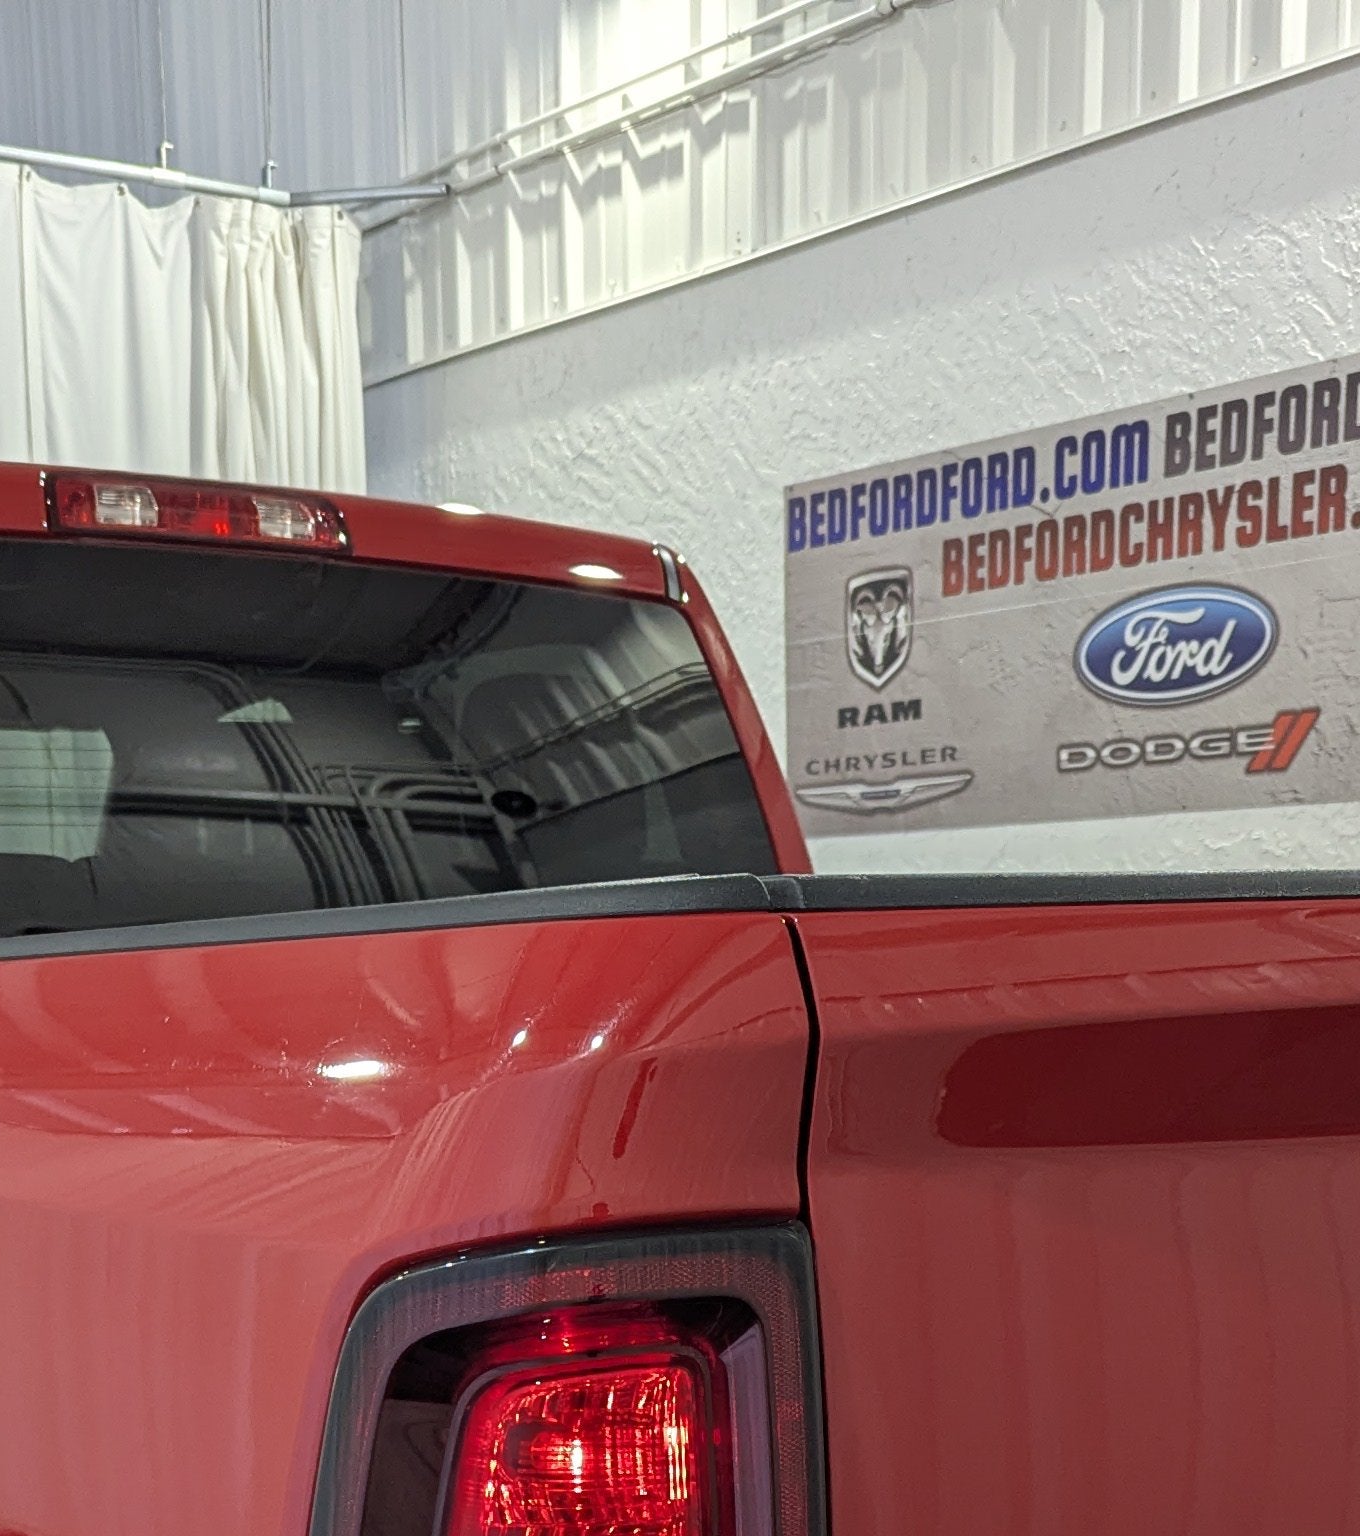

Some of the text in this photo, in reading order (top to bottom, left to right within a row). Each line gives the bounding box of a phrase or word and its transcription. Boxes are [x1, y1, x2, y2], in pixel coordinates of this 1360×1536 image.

[788, 419, 1150, 553] BEDFORDFORD.COM
[1111, 607, 1237, 686] Ford
[837, 699, 922, 729] RAM
[805, 745, 958, 775] CHRYSLER
[1057, 724, 1275, 773] DODGE
